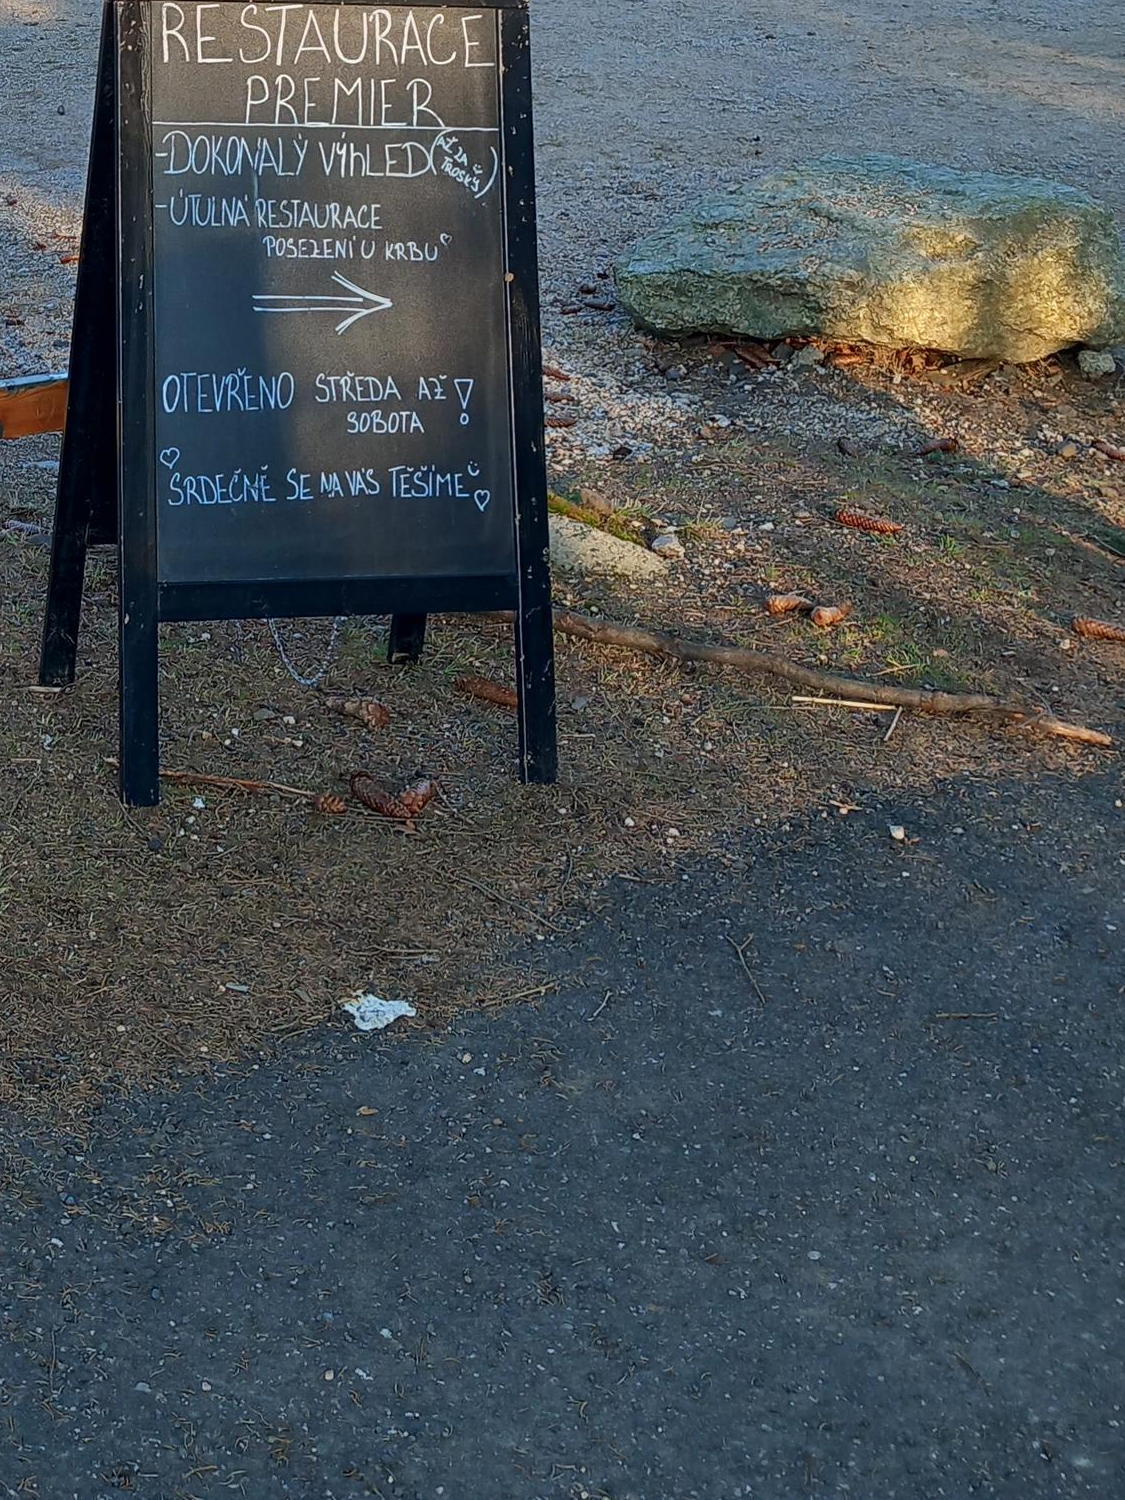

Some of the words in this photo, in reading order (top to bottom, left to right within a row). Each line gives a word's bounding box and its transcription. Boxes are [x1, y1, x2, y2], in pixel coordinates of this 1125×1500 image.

[161, 2, 495, 68] RESTAURACE
[245, 75, 446, 128] PREMIER
[256, 198, 383, 230] RESTAURACE
[262, 234, 357, 259] POSEZENÍ
[360, 240, 375, 259] U
[385, 240, 438, 261] KRBU
[162, 367, 295, 412] OTEVŘENO
[315, 370, 402, 402] STŘEDA
[418, 374, 447, 400] AŽ
[346, 410, 425, 434] SOBOTA
[168, 464, 276, 506] SRDEČNĚ
[286, 467, 313, 500] SE
[345, 467, 380, 497] VÁS
[388, 464, 470, 498] TĚŠÍME
